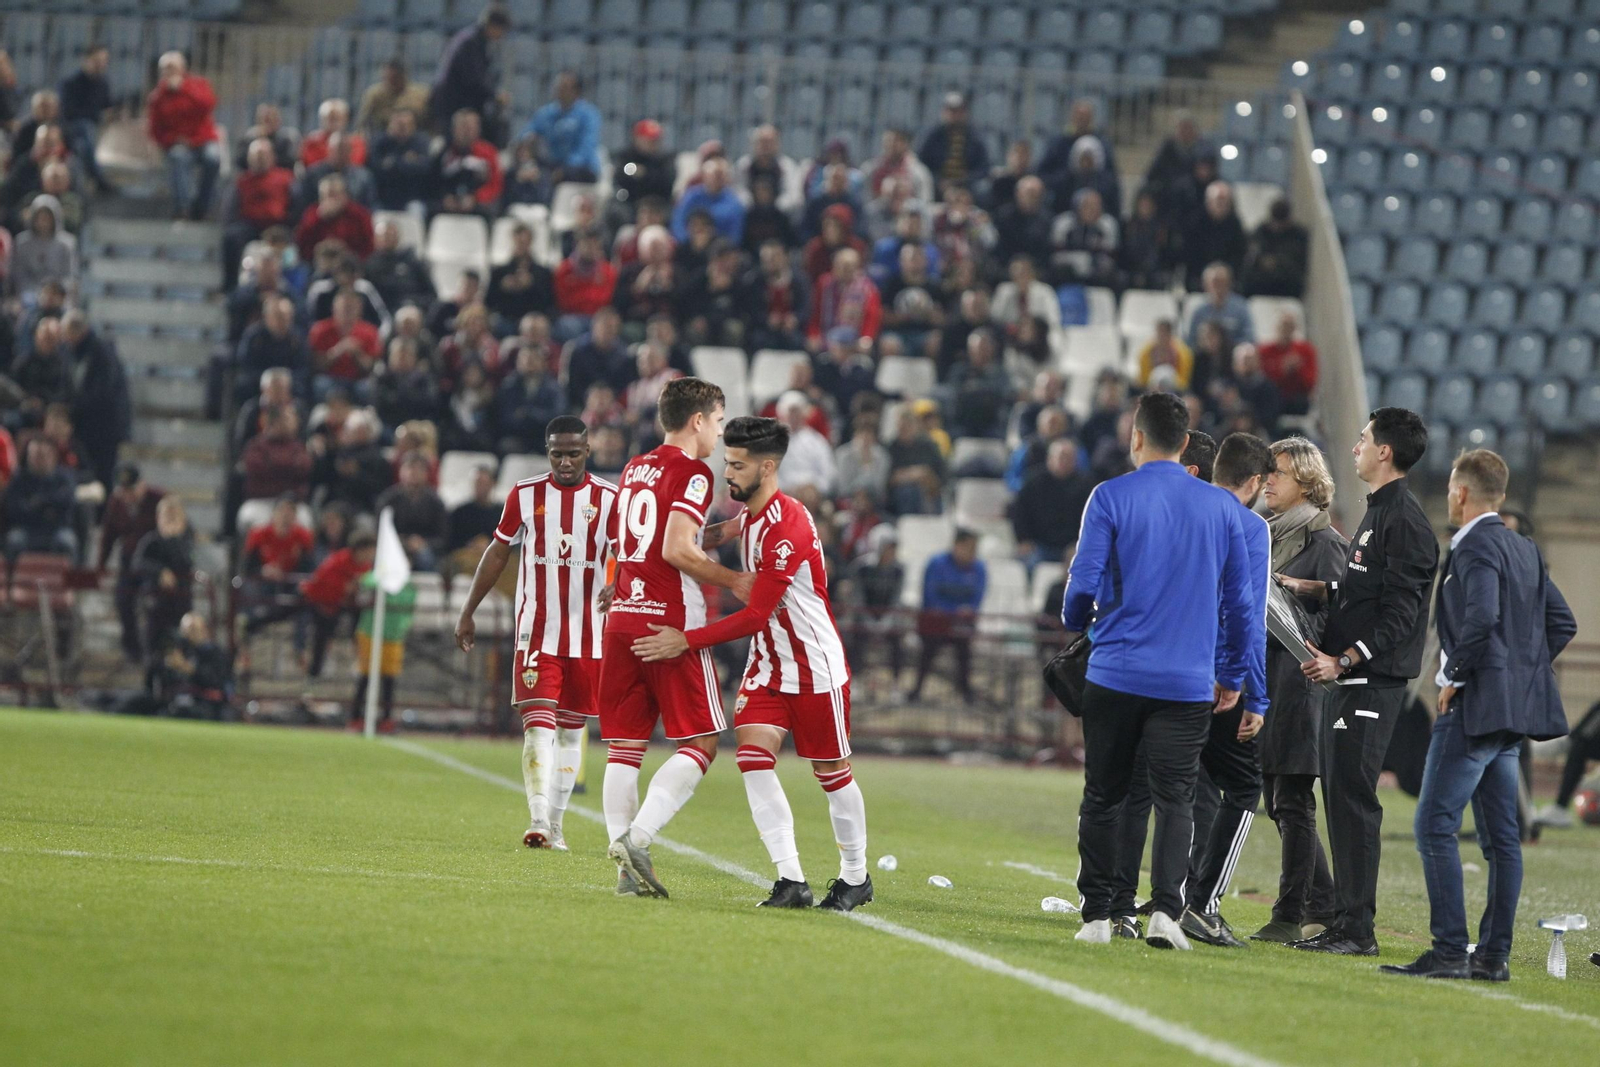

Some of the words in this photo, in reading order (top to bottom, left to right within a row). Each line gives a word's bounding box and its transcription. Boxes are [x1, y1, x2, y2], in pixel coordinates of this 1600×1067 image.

[617, 487, 658, 562] 19
[534, 554, 564, 566] Arabian
[566, 558, 595, 568] Centres
[522, 650, 540, 667] 12
